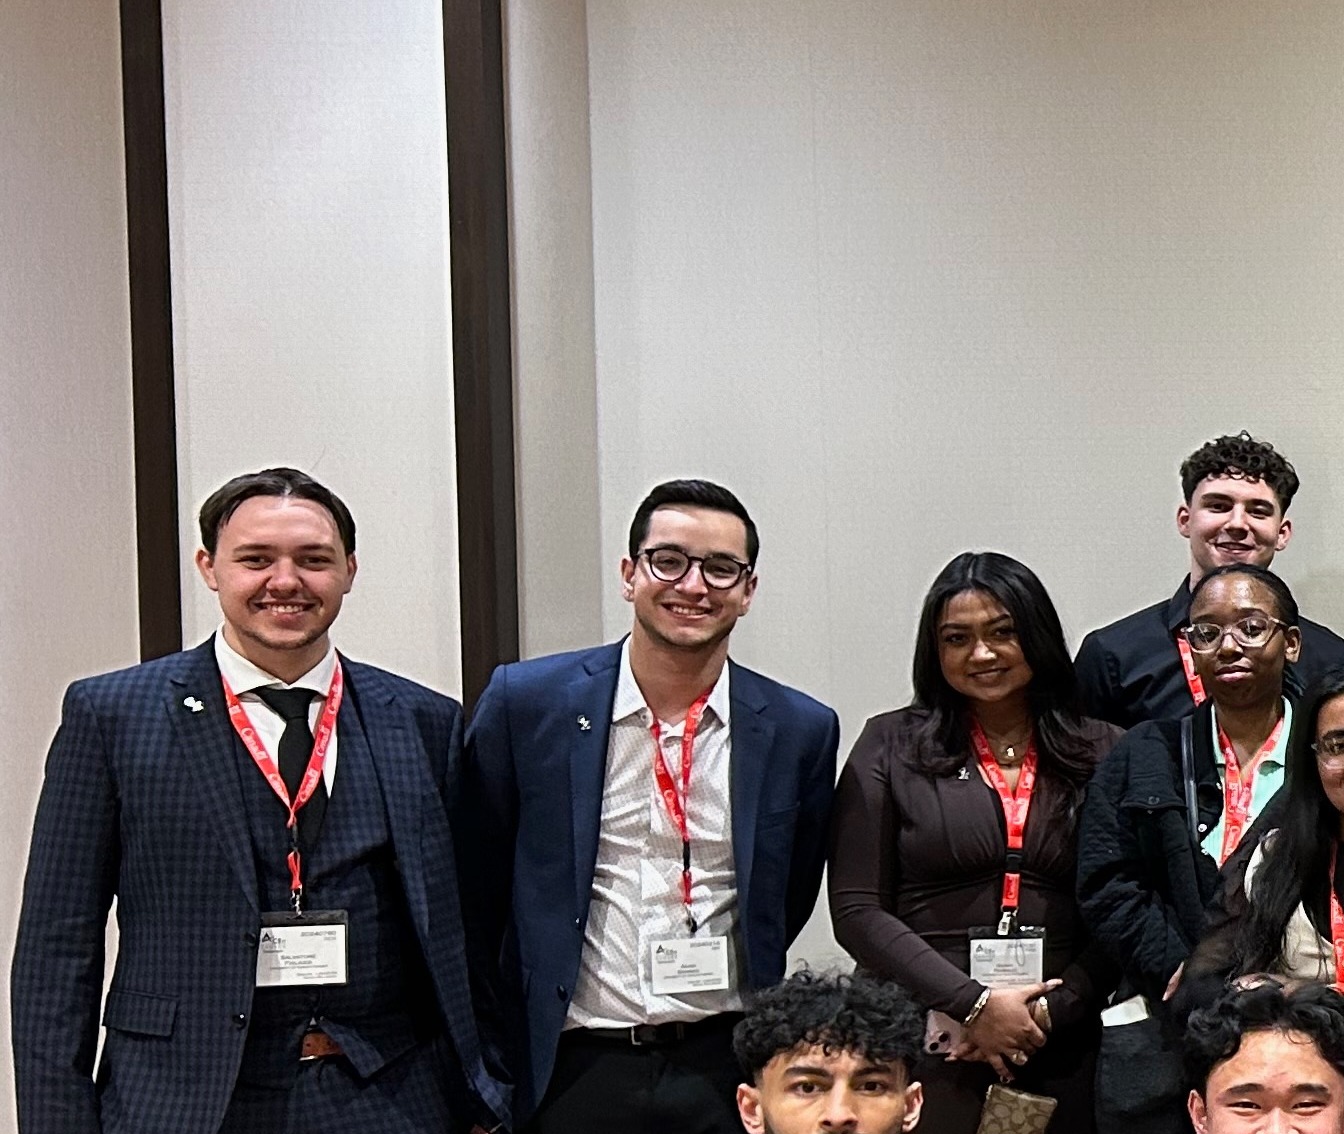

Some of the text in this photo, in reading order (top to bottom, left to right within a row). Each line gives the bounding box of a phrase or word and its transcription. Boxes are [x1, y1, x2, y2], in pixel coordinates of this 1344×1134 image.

[241, 727, 269, 761] Canada
[316, 724, 331, 757] Canada
[300, 768, 319, 801] Canada
